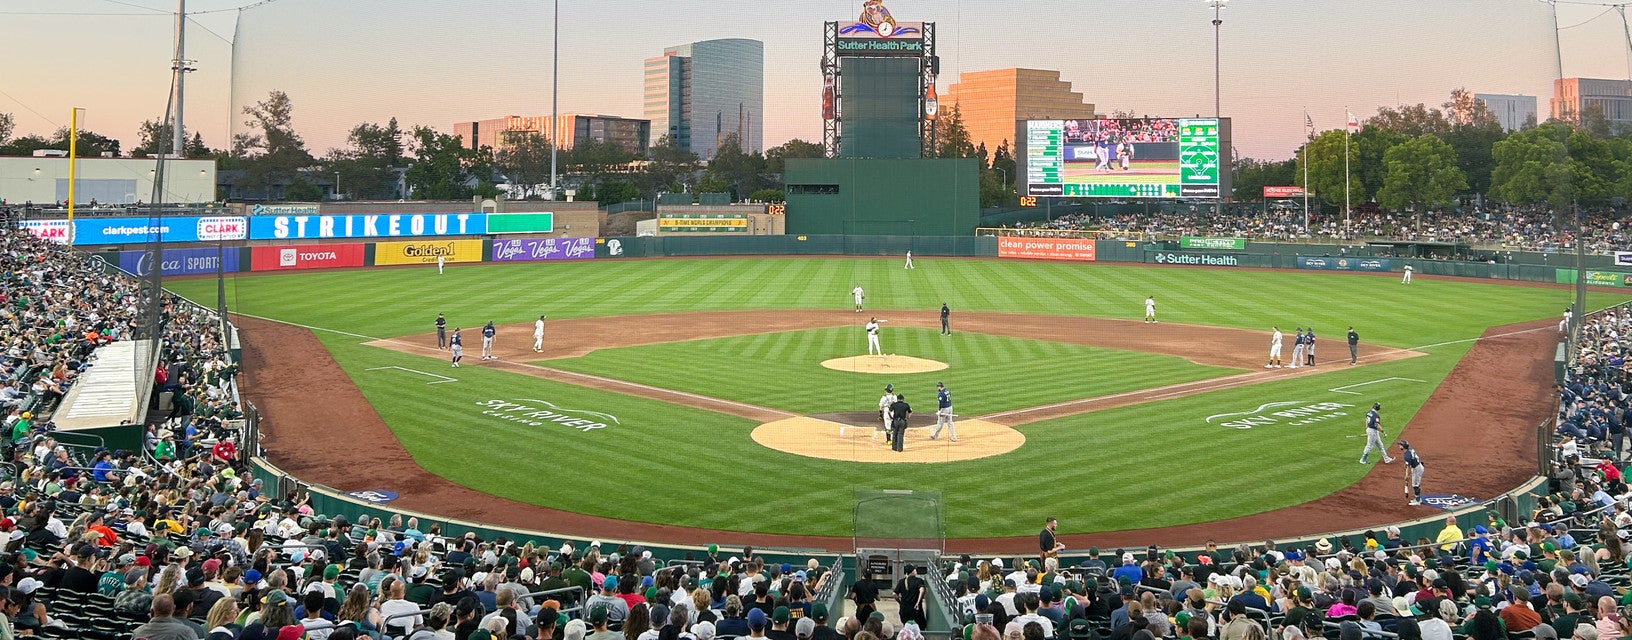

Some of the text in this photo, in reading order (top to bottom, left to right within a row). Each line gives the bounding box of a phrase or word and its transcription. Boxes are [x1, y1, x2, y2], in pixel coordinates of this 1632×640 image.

[838, 40, 922, 51] Sutter Health Park
[1021, 196, 1036, 206] 0:22
[769, 205, 784, 214] 0:22
[102, 226, 169, 236] clarkpest.com
[205, 224, 238, 233] CLARK
[493, 241, 526, 259] Vegas
[527, 241, 560, 258] Vegas
[562, 240, 594, 257] Vegas
[1001, 239, 1092, 252] clean power promise
[300, 252, 336, 260] TOYOTA
[1167, 253, 1237, 265] Sutter Health
[1592, 272, 1618, 281] Sports
[476, 399, 607, 432] SKY RIVER
[1220, 415, 1278, 429] SKY
[1272, 402, 1355, 418] RIVER
